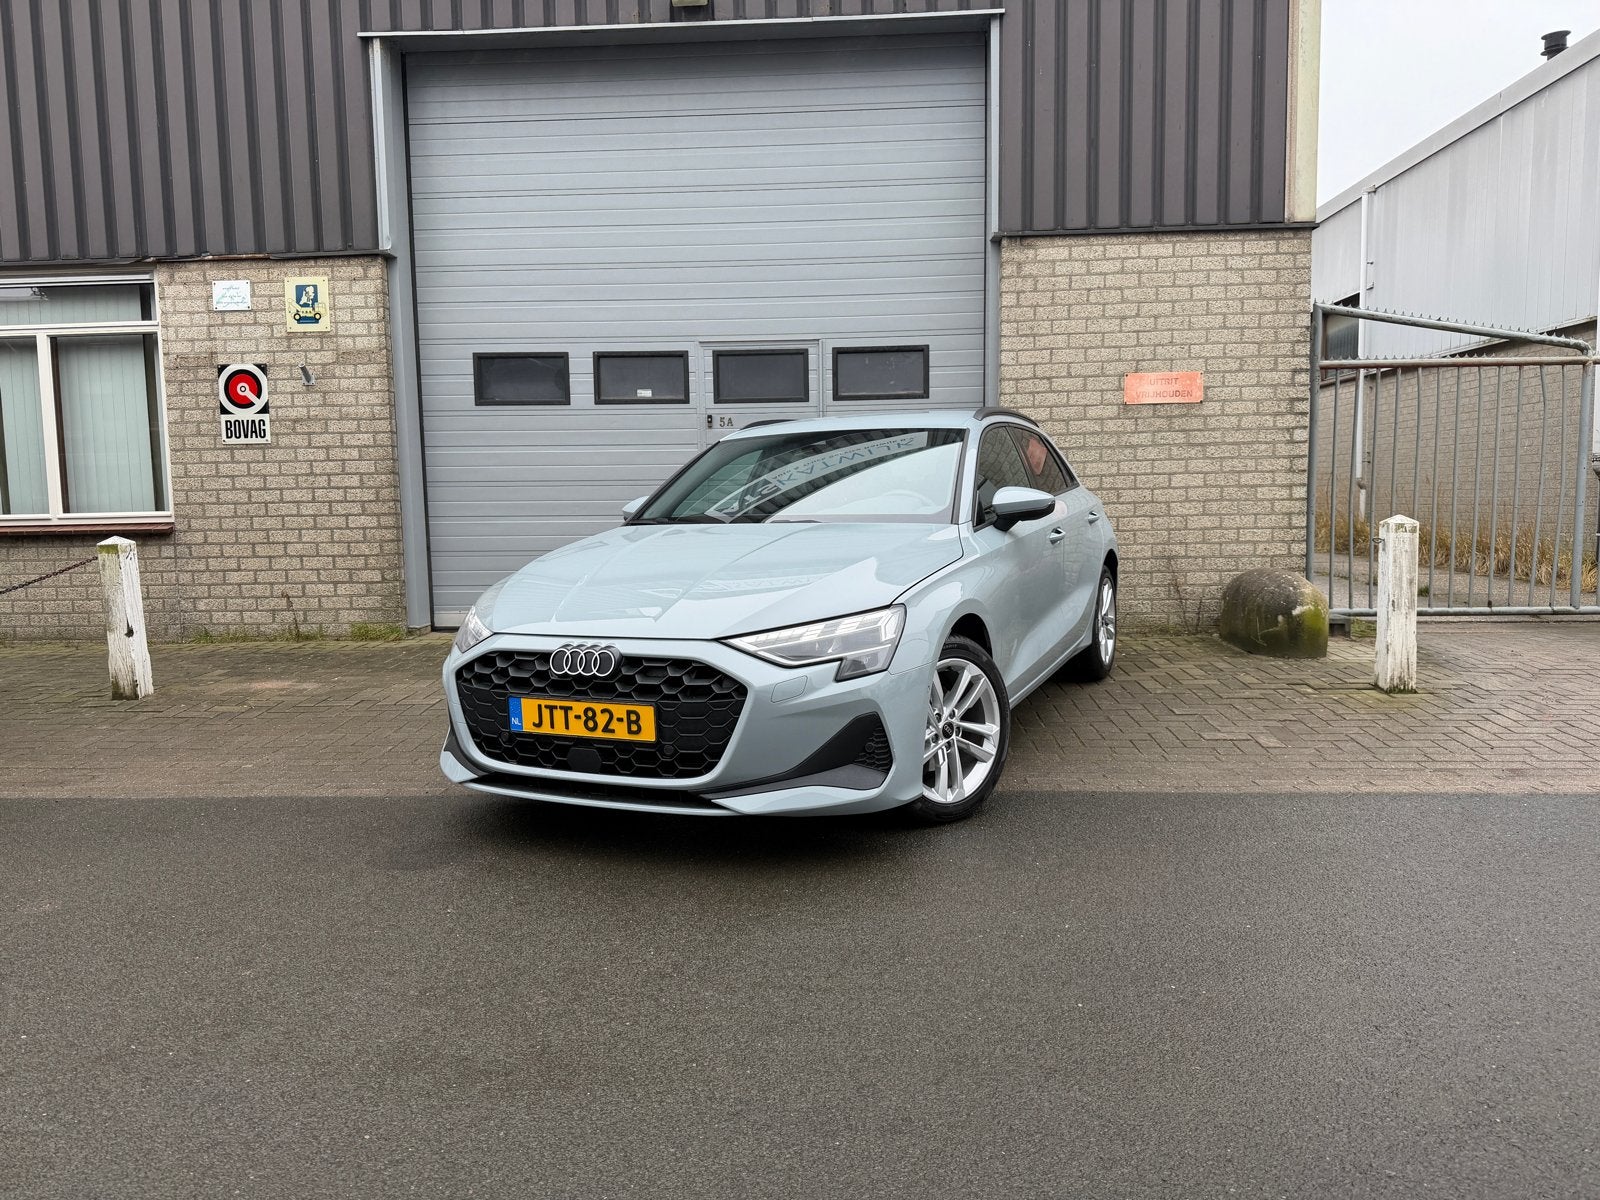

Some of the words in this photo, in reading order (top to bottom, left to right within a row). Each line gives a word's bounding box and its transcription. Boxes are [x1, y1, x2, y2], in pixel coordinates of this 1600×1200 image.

[1149, 377, 1179, 385] UITRIT
[1136, 389, 1193, 398] VRIJHOUDEN
[719, 416, 734, 428] 5A
[224, 418, 267, 440] BOVAG
[511, 717, 521, 725] NL
[532, 703, 642, 735] JTT-82-B
